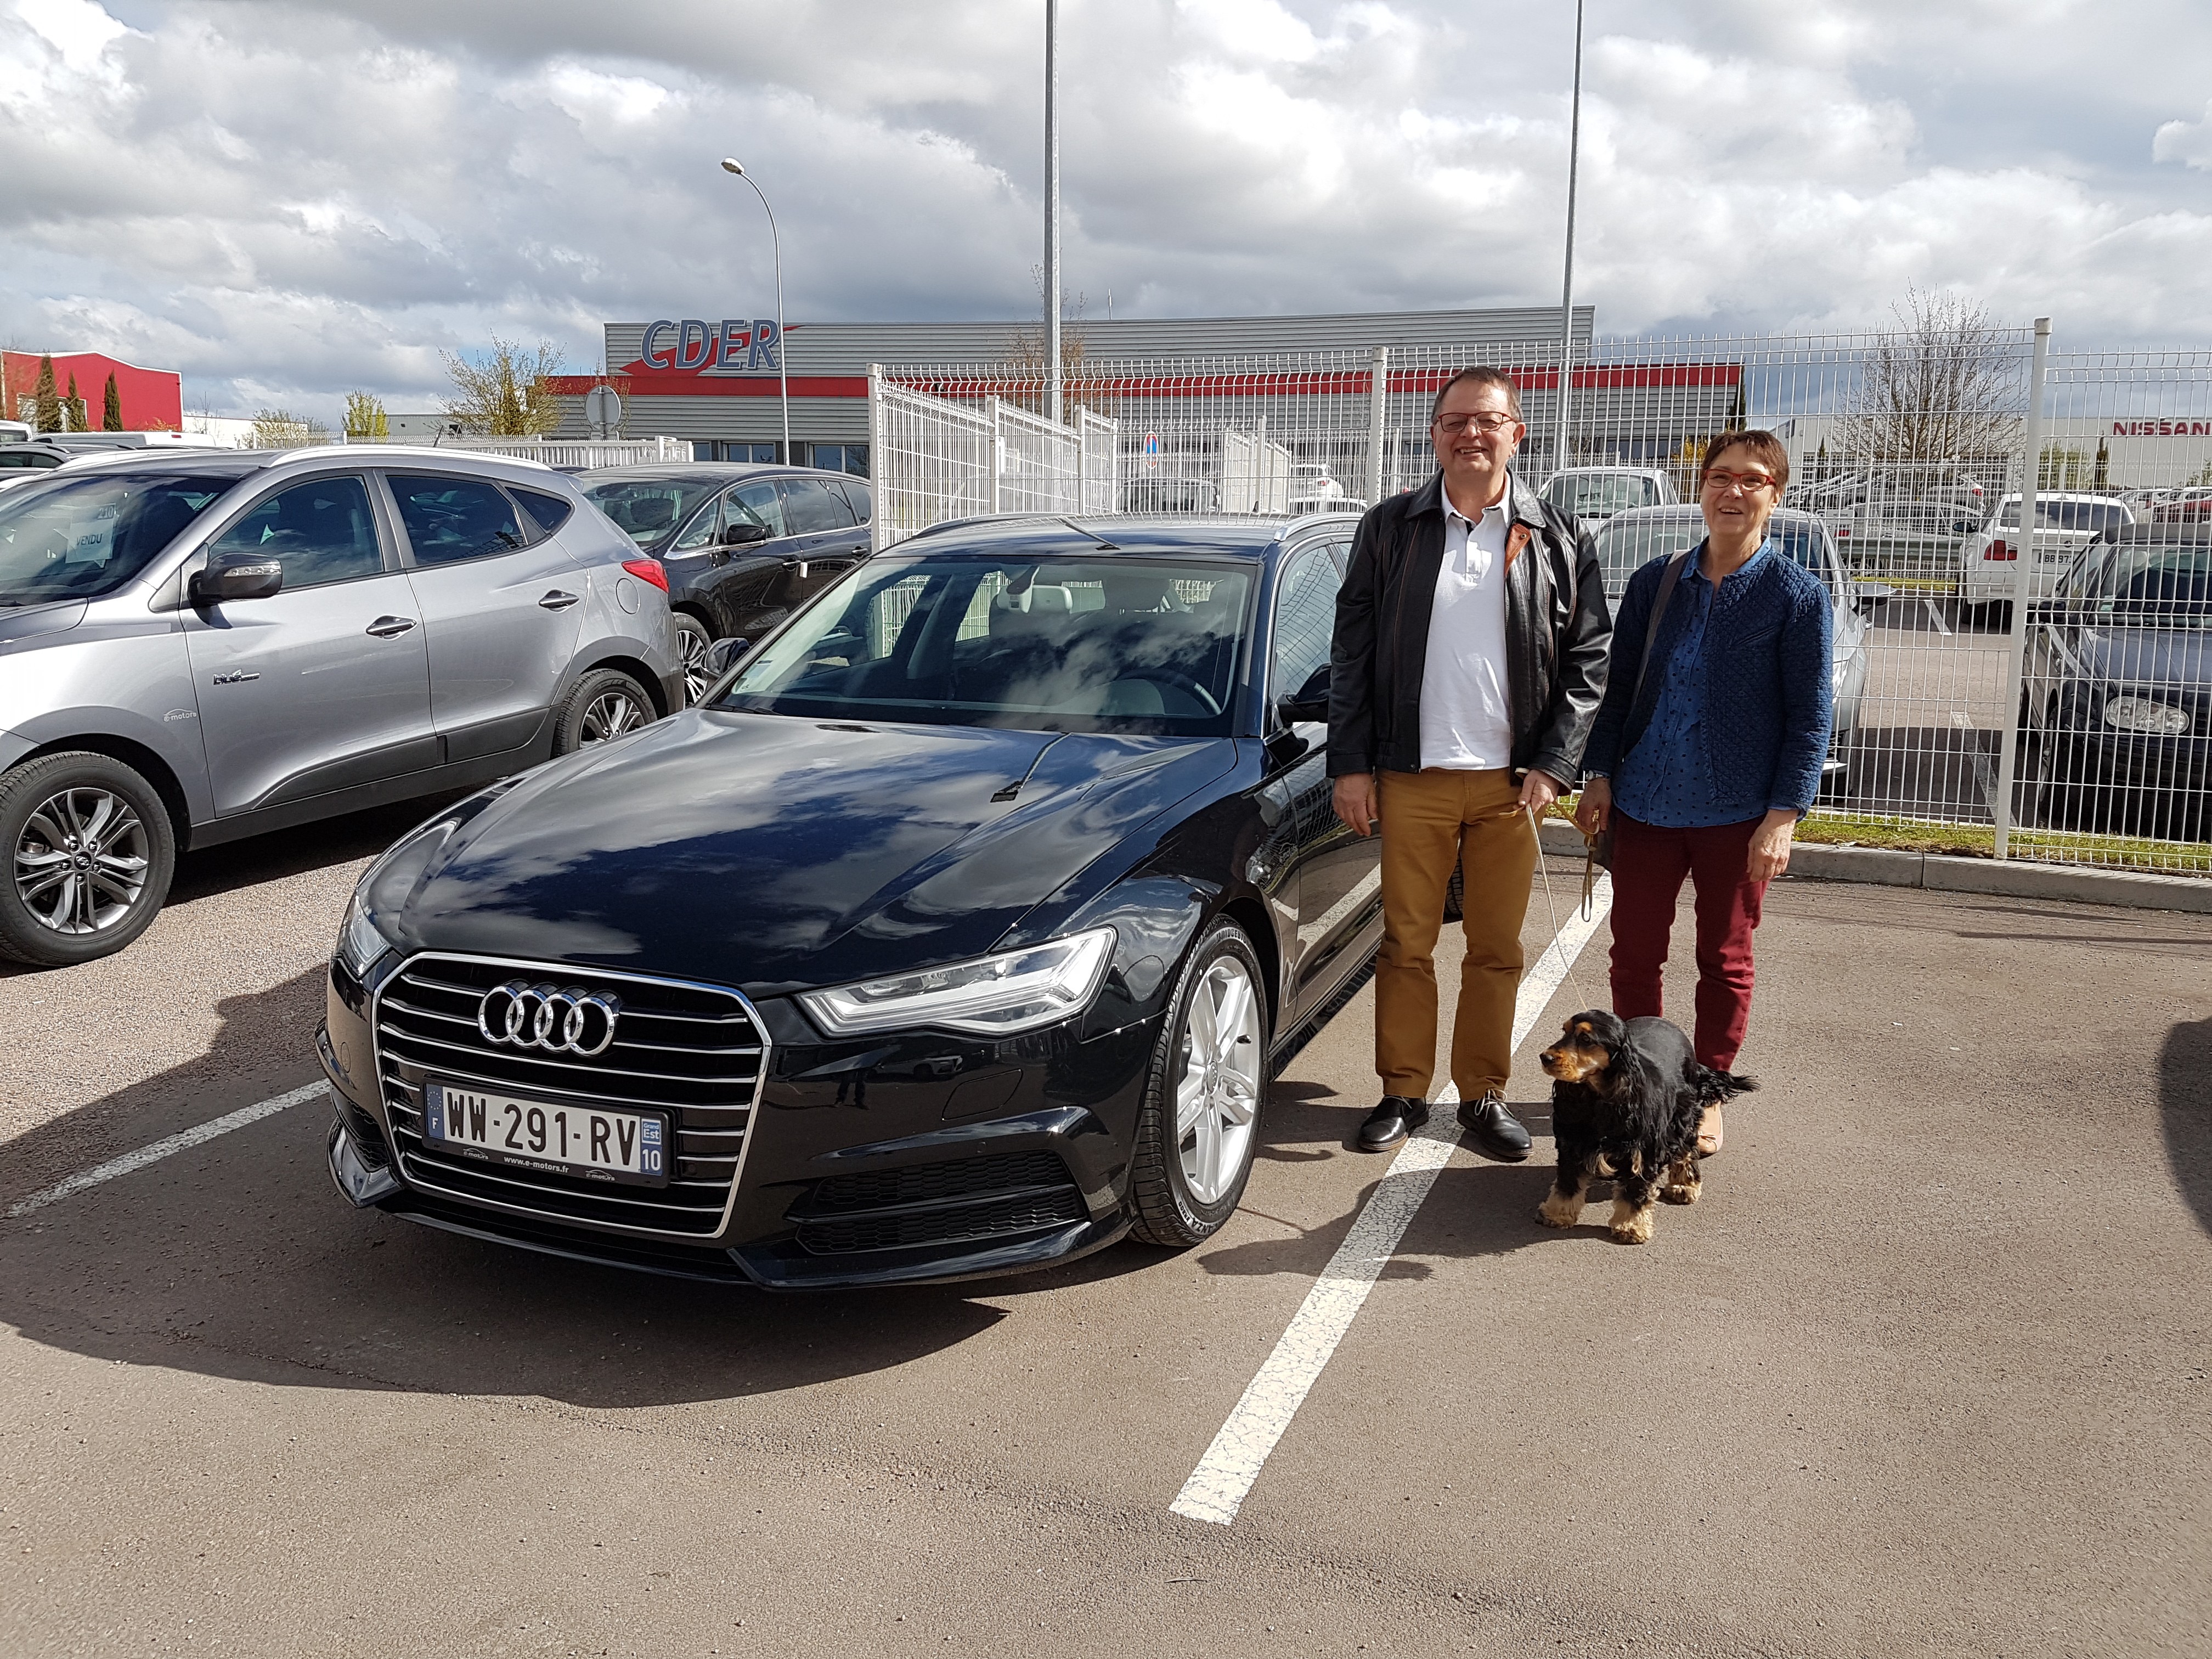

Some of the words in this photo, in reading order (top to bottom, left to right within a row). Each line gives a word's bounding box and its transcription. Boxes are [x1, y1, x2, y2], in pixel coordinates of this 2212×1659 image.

[641, 319, 779, 370] CDER
[2113, 421, 2210, 435] NISSAN
[98, 505, 114, 519] 210
[77, 533, 103, 545] VENDU
[163, 712, 197, 722] e-motors
[432, 1117, 438, 1129] F
[447, 1092, 636, 1166] WW-291-RV
[644, 1128, 659, 1139] Est
[504, 1155, 570, 1173] www.e-motors.fr
[642, 1149, 661, 1171] 10
